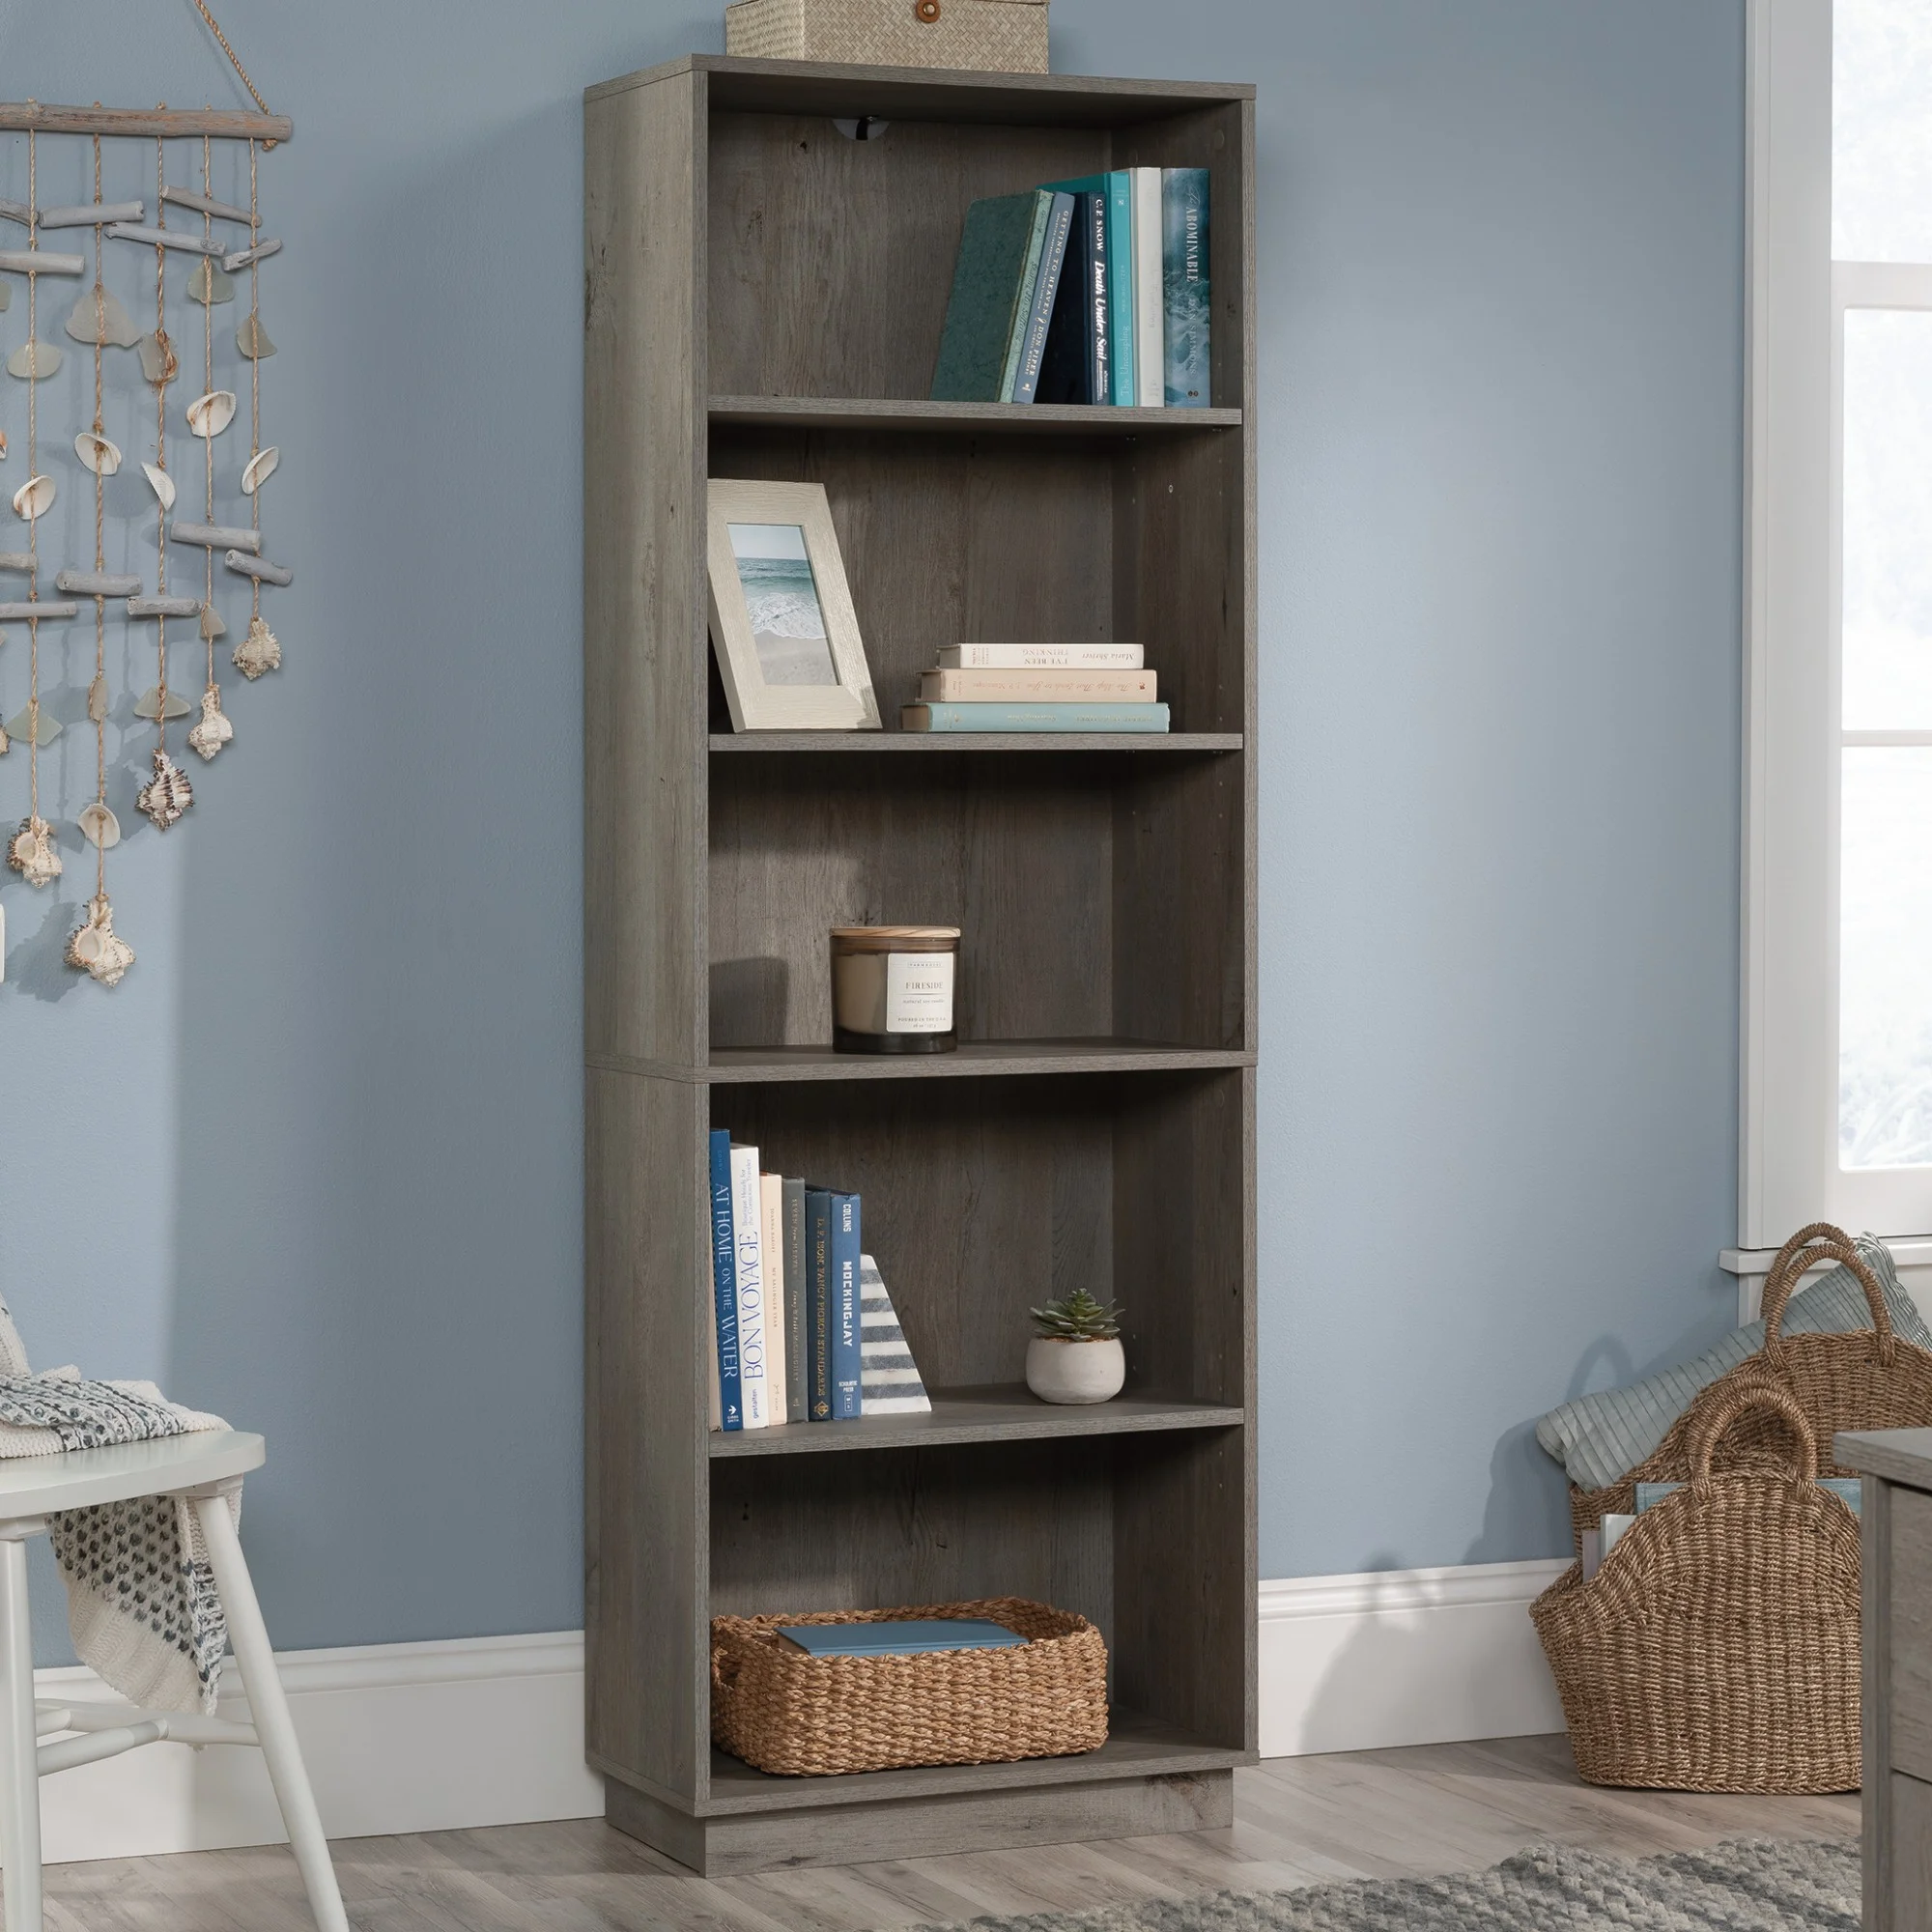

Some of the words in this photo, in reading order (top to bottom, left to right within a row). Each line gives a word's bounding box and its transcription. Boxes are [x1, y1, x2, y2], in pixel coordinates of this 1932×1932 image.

[1055, 211, 1069, 254] GETTING
[1185, 207, 1198, 283] ABOMINABLE
[1052, 258, 1059, 270] TO
[1094, 261, 1106, 295] Death
[1042, 276, 1055, 316] HEAVEN
[1188, 298, 1197, 321] DAN
[1095, 298, 1107, 335] Under
[1036, 326, 1044, 346] DON
[1096, 337, 1108, 360] Sail
[1120, 326, 1130, 375] Uncoupling
[1189, 325, 1198, 375] SIMMONS
[1029, 349, 1039, 376] PIPER
[905, 981, 944, 990] FIRESIDE
[715, 1183, 729, 1205] AT
[842, 1204, 851, 1232] COLLINS
[717, 1210, 733, 1263] HOME
[722, 1268, 731, 1285] ON
[738, 1232, 761, 1322] VOYAGE
[817, 1267, 826, 1298] FANCY
[723, 1287, 732, 1310] THE
[842, 1261, 852, 1347] MOCKINGJAY
[722, 1315, 738, 1378] WATER
[742, 1328, 763, 1379] BON
